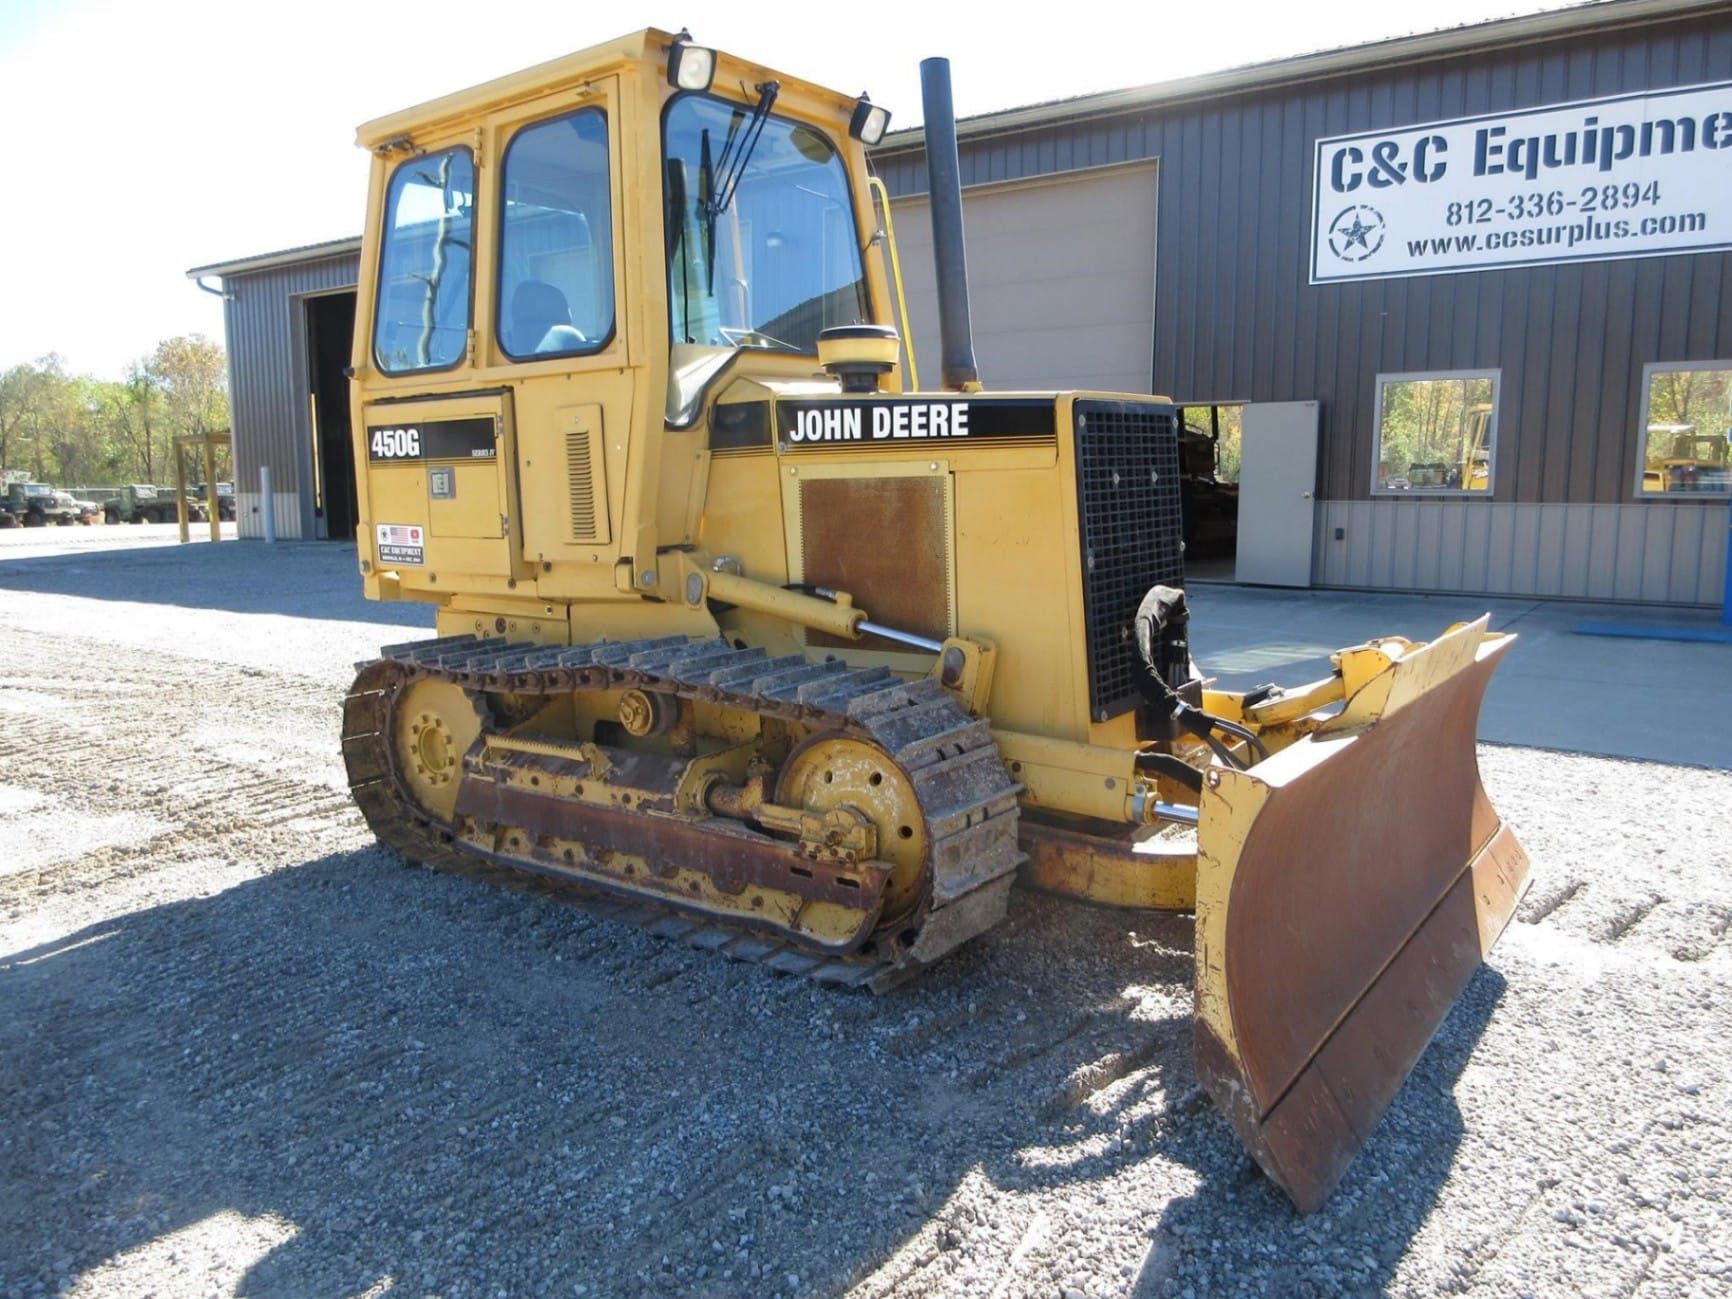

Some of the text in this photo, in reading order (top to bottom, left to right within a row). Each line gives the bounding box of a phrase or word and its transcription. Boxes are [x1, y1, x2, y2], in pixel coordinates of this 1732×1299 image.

[1331, 112, 1732, 192] C&C Equipme
[1446, 181, 1661, 226] 812-336-2894
[1407, 212, 1706, 257] www.ccsurplus.com
[371, 429, 420, 457] 450G
[790, 403, 969, 442] JOHN DEERE
